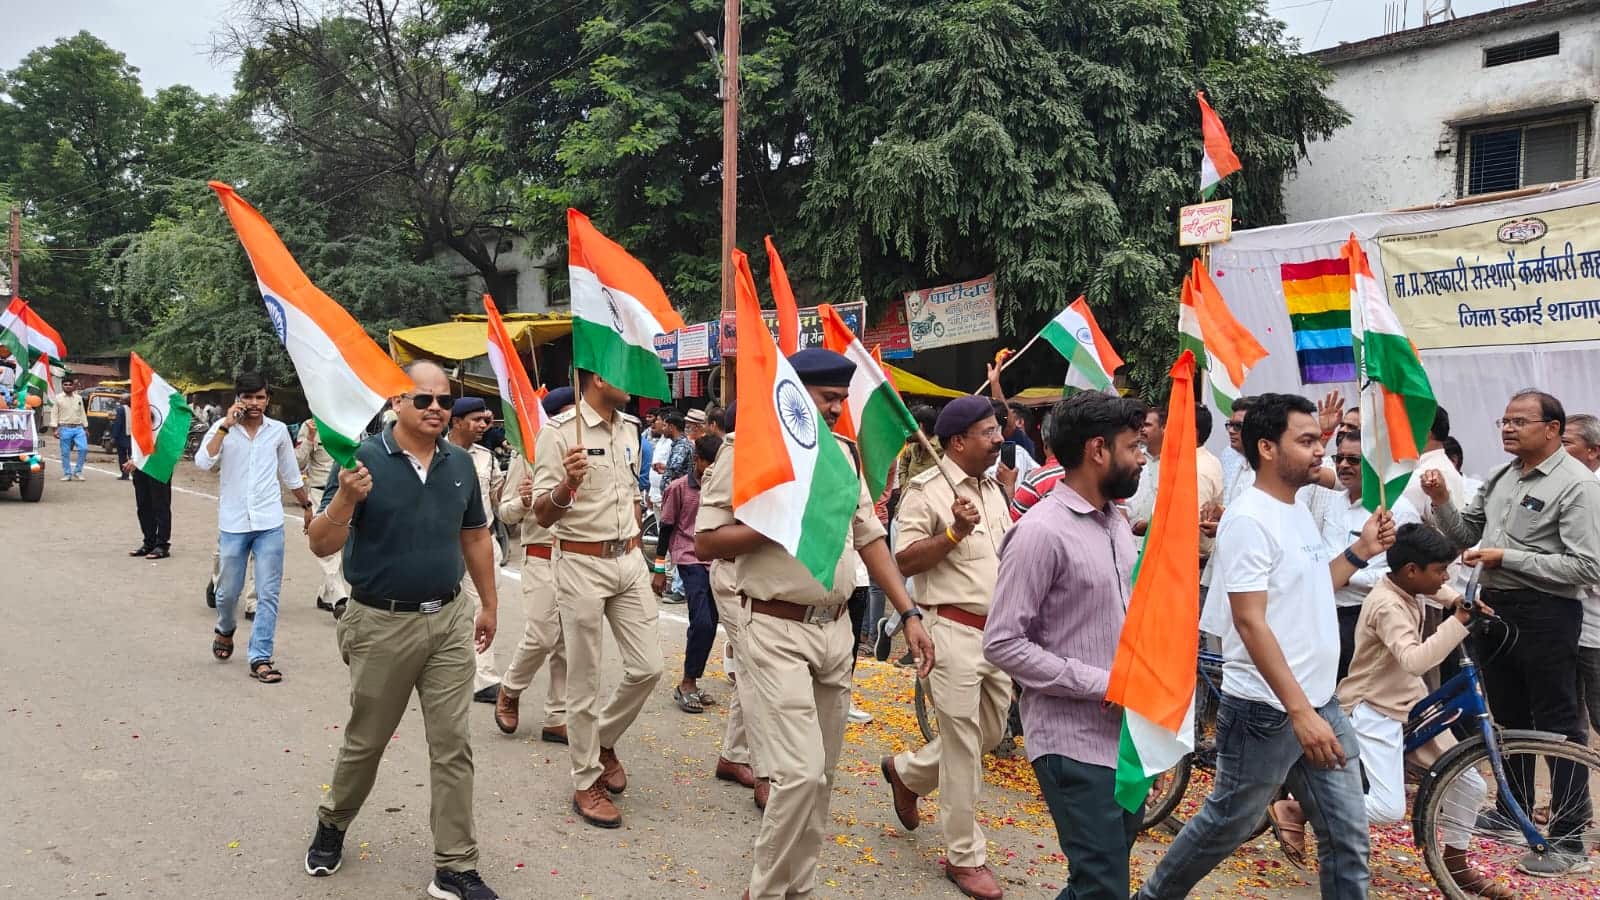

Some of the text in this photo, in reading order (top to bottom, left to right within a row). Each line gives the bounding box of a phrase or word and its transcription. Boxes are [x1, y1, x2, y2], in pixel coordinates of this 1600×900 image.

[1518, 242, 1577, 285] कर्मचारी
[1458, 303, 1496, 328] जिला
[1498, 297, 1543, 327] इकाई
